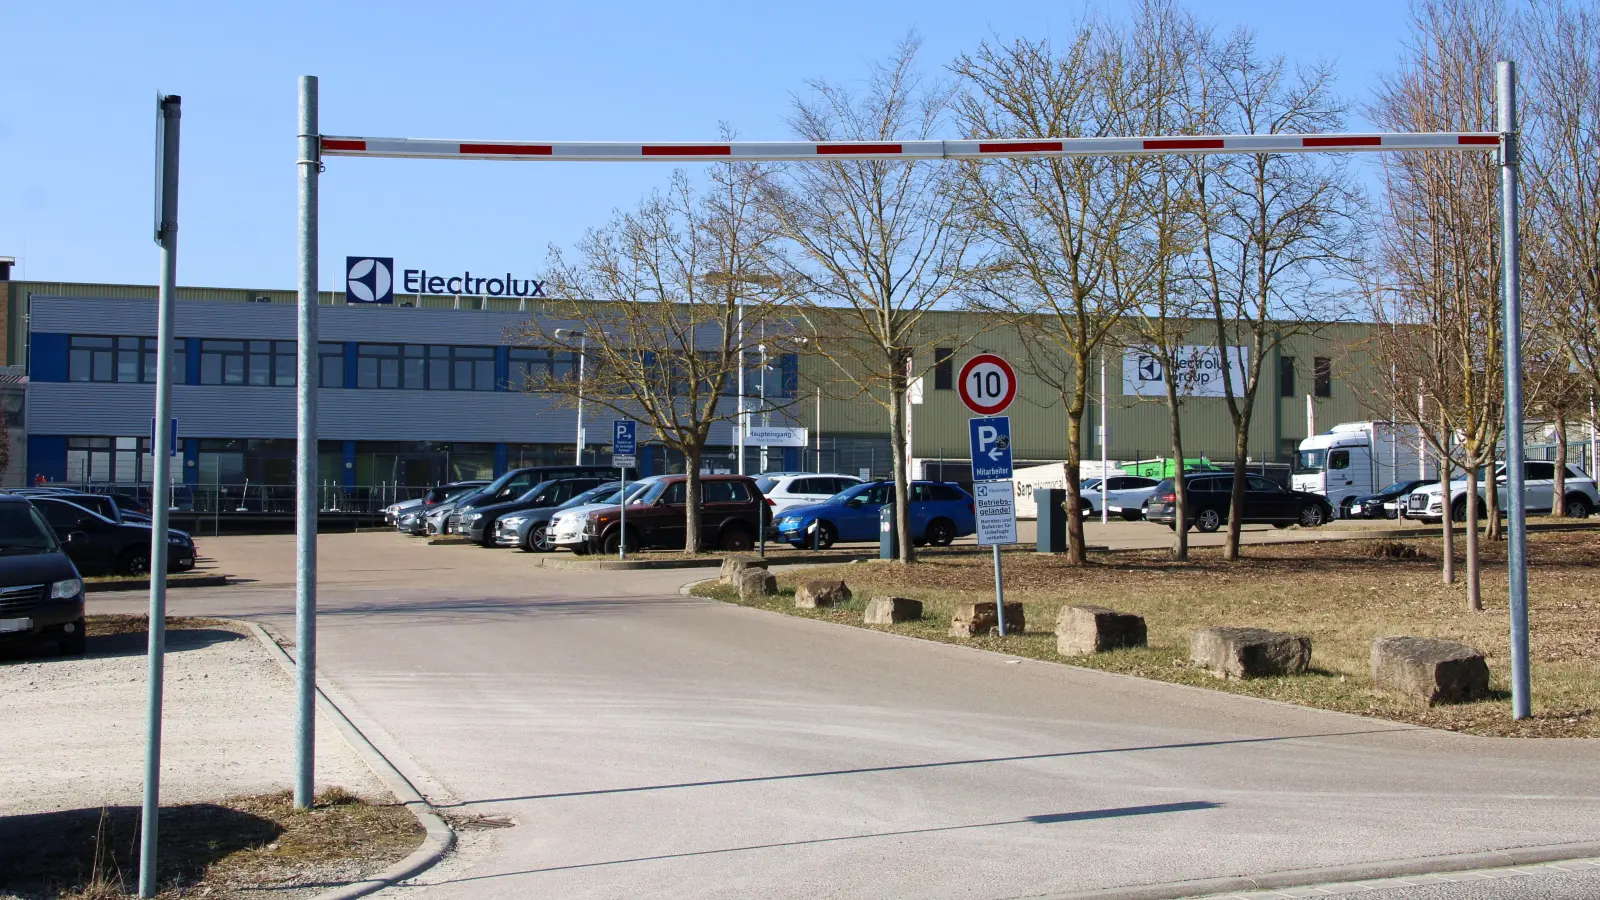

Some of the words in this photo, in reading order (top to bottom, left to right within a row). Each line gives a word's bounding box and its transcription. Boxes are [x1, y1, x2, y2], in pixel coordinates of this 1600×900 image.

[404, 269, 545, 297] Electrolux
[973, 371, 1001, 399] 10
[616, 425, 627, 440] P
[978, 425, 998, 452] P
[976, 467, 1009, 476] Mitarbeiter
[978, 498, 1012, 507] Betriebs-
[979, 506, 1011, 516] gelände!
